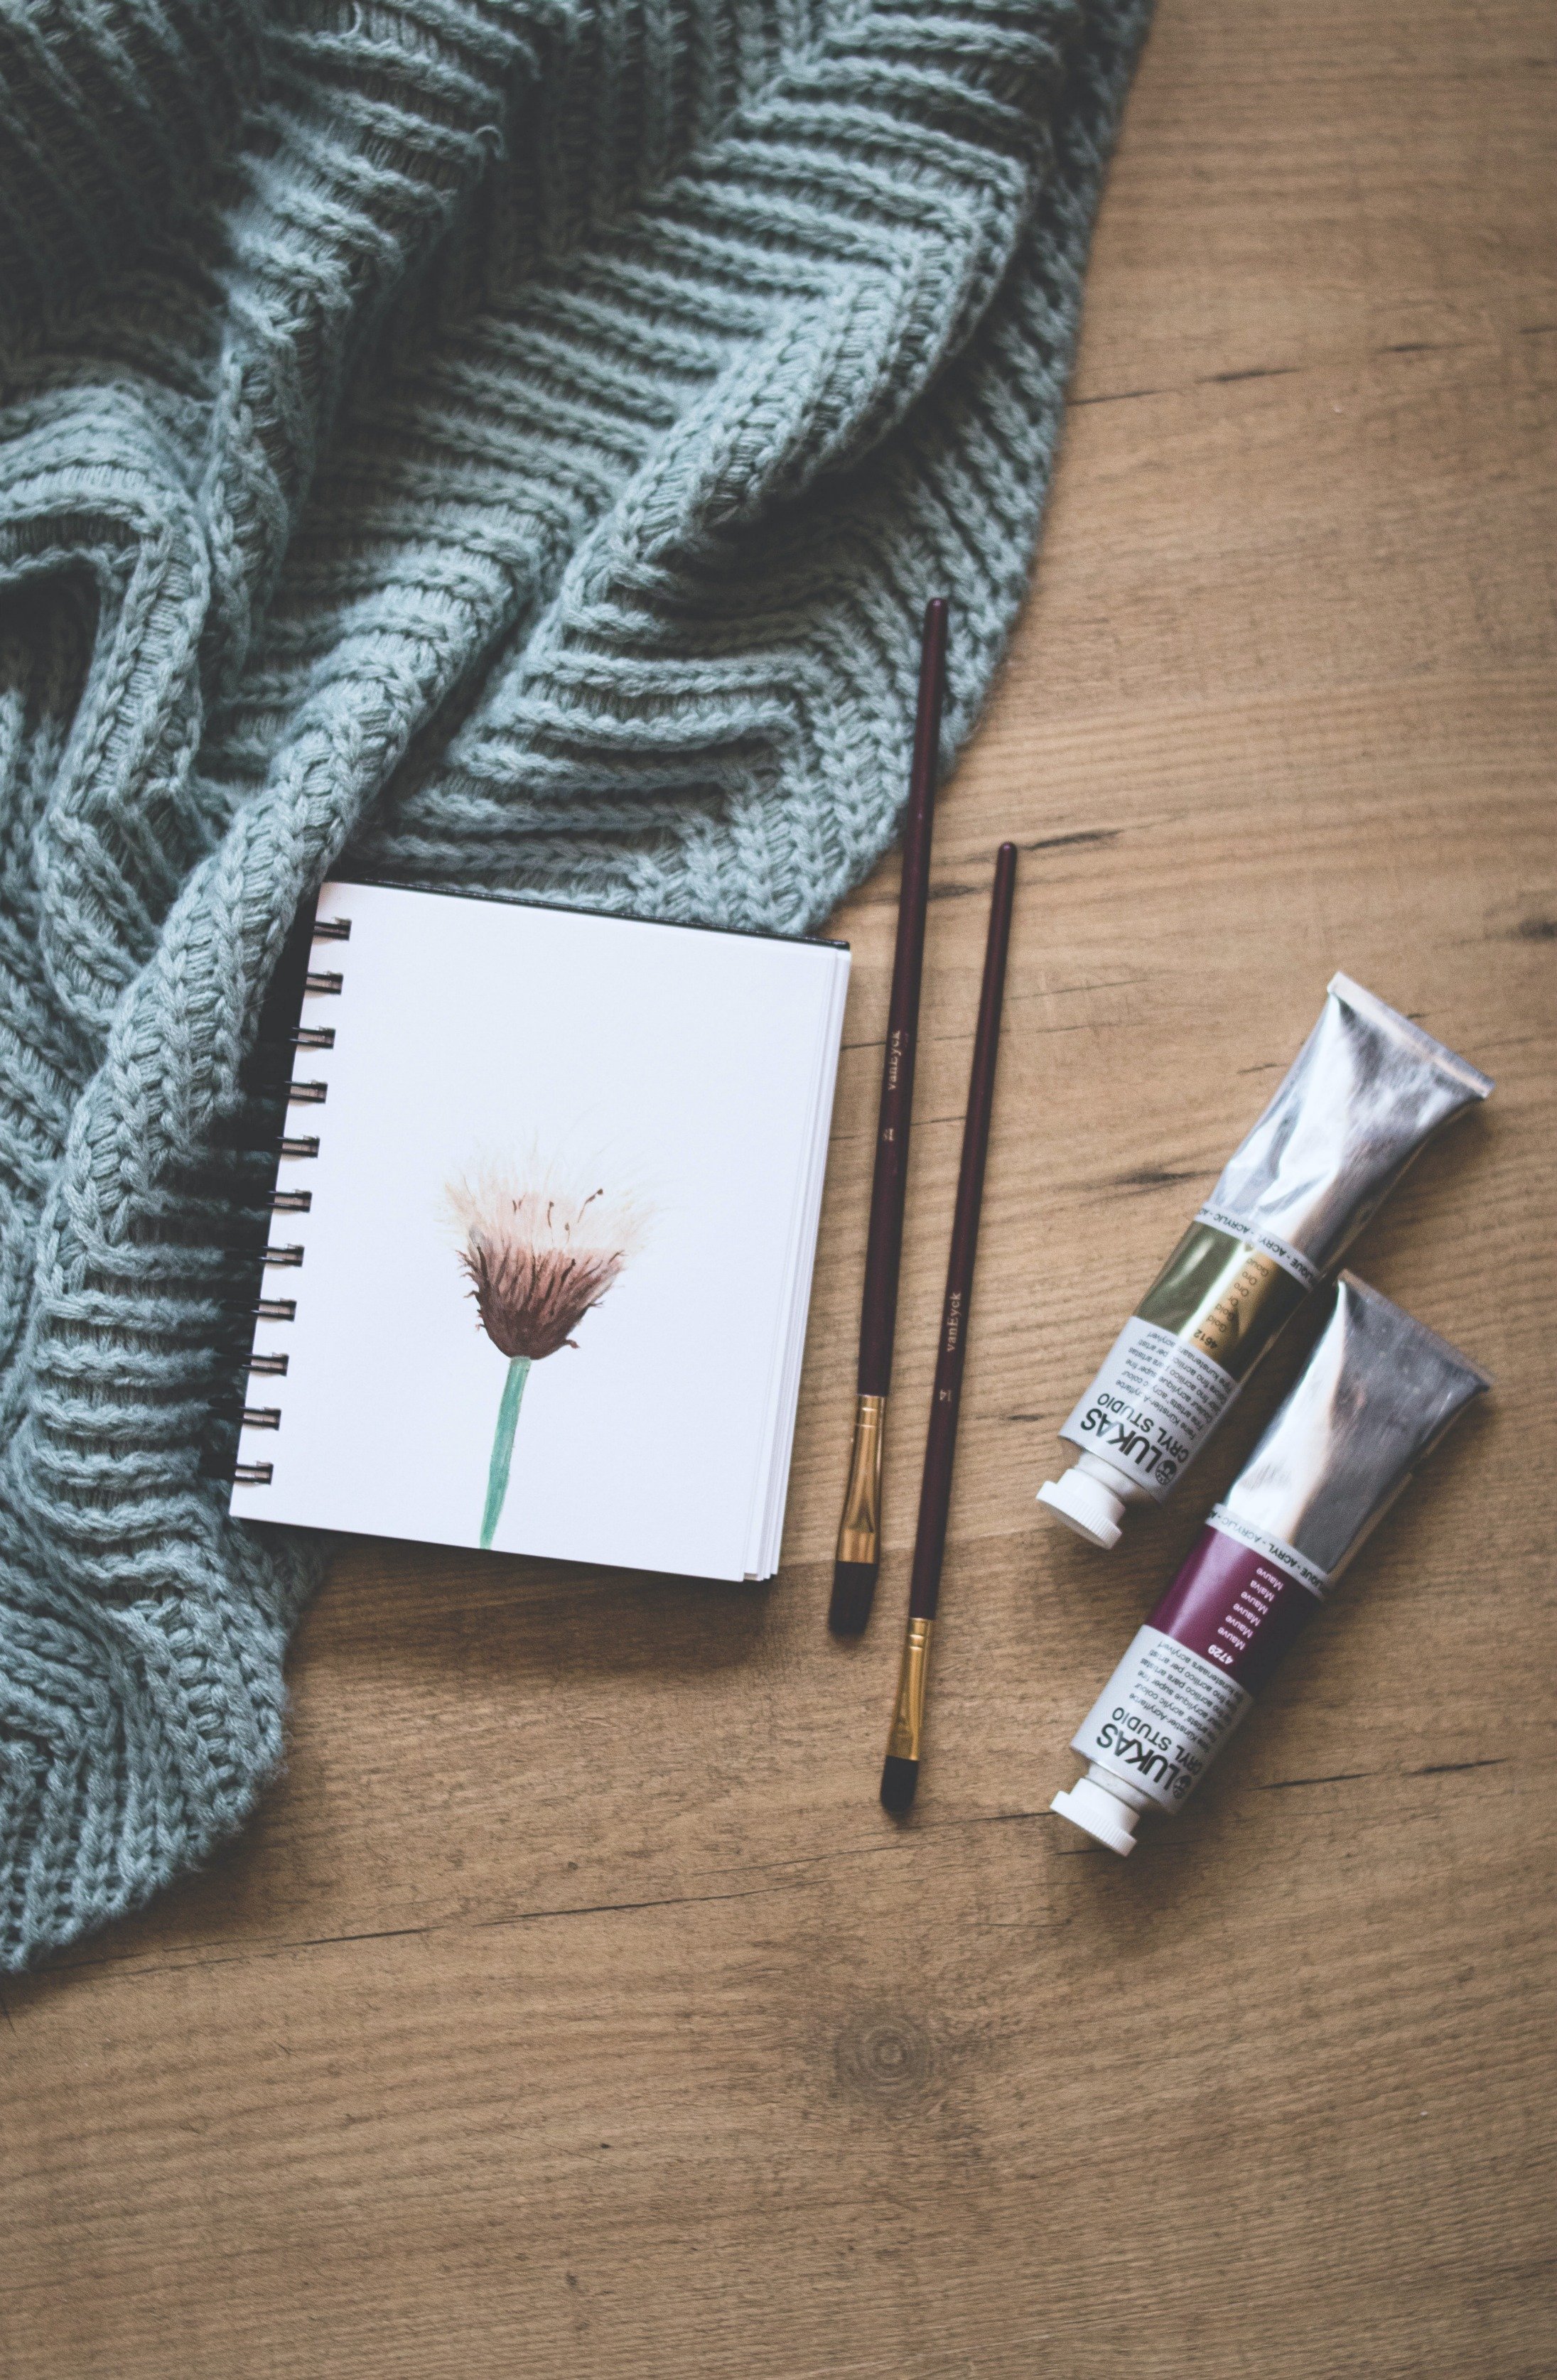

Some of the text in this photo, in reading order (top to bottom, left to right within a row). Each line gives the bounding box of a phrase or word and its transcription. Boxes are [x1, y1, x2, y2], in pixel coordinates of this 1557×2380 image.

[888, 1030, 903, 1091] vanEyck
[1215, 1213, 1250, 1234] ACRYLIC
[1256, 1234, 1286, 1257] ACRY
[1234, 1282, 1250, 1297] Oro
[1241, 1271, 1257, 1286] Oro
[945, 1292, 961, 1352] vanEyck
[1206, 1314, 1227, 1333] Gold
[1193, 1329, 1218, 1349] 4612
[1128, 1347, 1152, 1363] artistas
[1121, 1368, 1143, 1385] colour
[1144, 1380, 1168, 1399] acryc
[1159, 1375, 1192, 1402] acrylique
[1115, 1378, 1180, 1426] Künstler-Arylfarbe
[1097, 1392, 1190, 1463] CRYL STUDIO
[1079, 1407, 1163, 1473] LUKAS
[1221, 1517, 1261, 1543] ACRYLIC
[1268, 1543, 1298, 1567] ACRYL
[1256, 1567, 1283, 1591] Mauve
[1249, 1580, 1275, 1601] Malva
[1240, 1591, 1268, 1614] Mauve
[1233, 1603, 1261, 1626] Mauve
[1225, 1614, 1254, 1638] Mauve
[1217, 1626, 1246, 1650] Mauve
[1207, 1643, 1234, 1665] 4729
[1137, 1670, 1151, 1682] fine
[1140, 1657, 1166, 1676] artistas
[1171, 1661, 1185, 1672] per
[1134, 1682, 1158, 1699] colour
[1151, 1679, 1174, 1695] super
[1168, 1673, 1185, 1688] para
[1159, 1697, 1184, 1716] acrylic
[1175, 1692, 1208, 1718] acrylique
[1111, 1706, 1172, 1751] STUDIO
[1095, 1722, 1180, 1790] LUKAS
